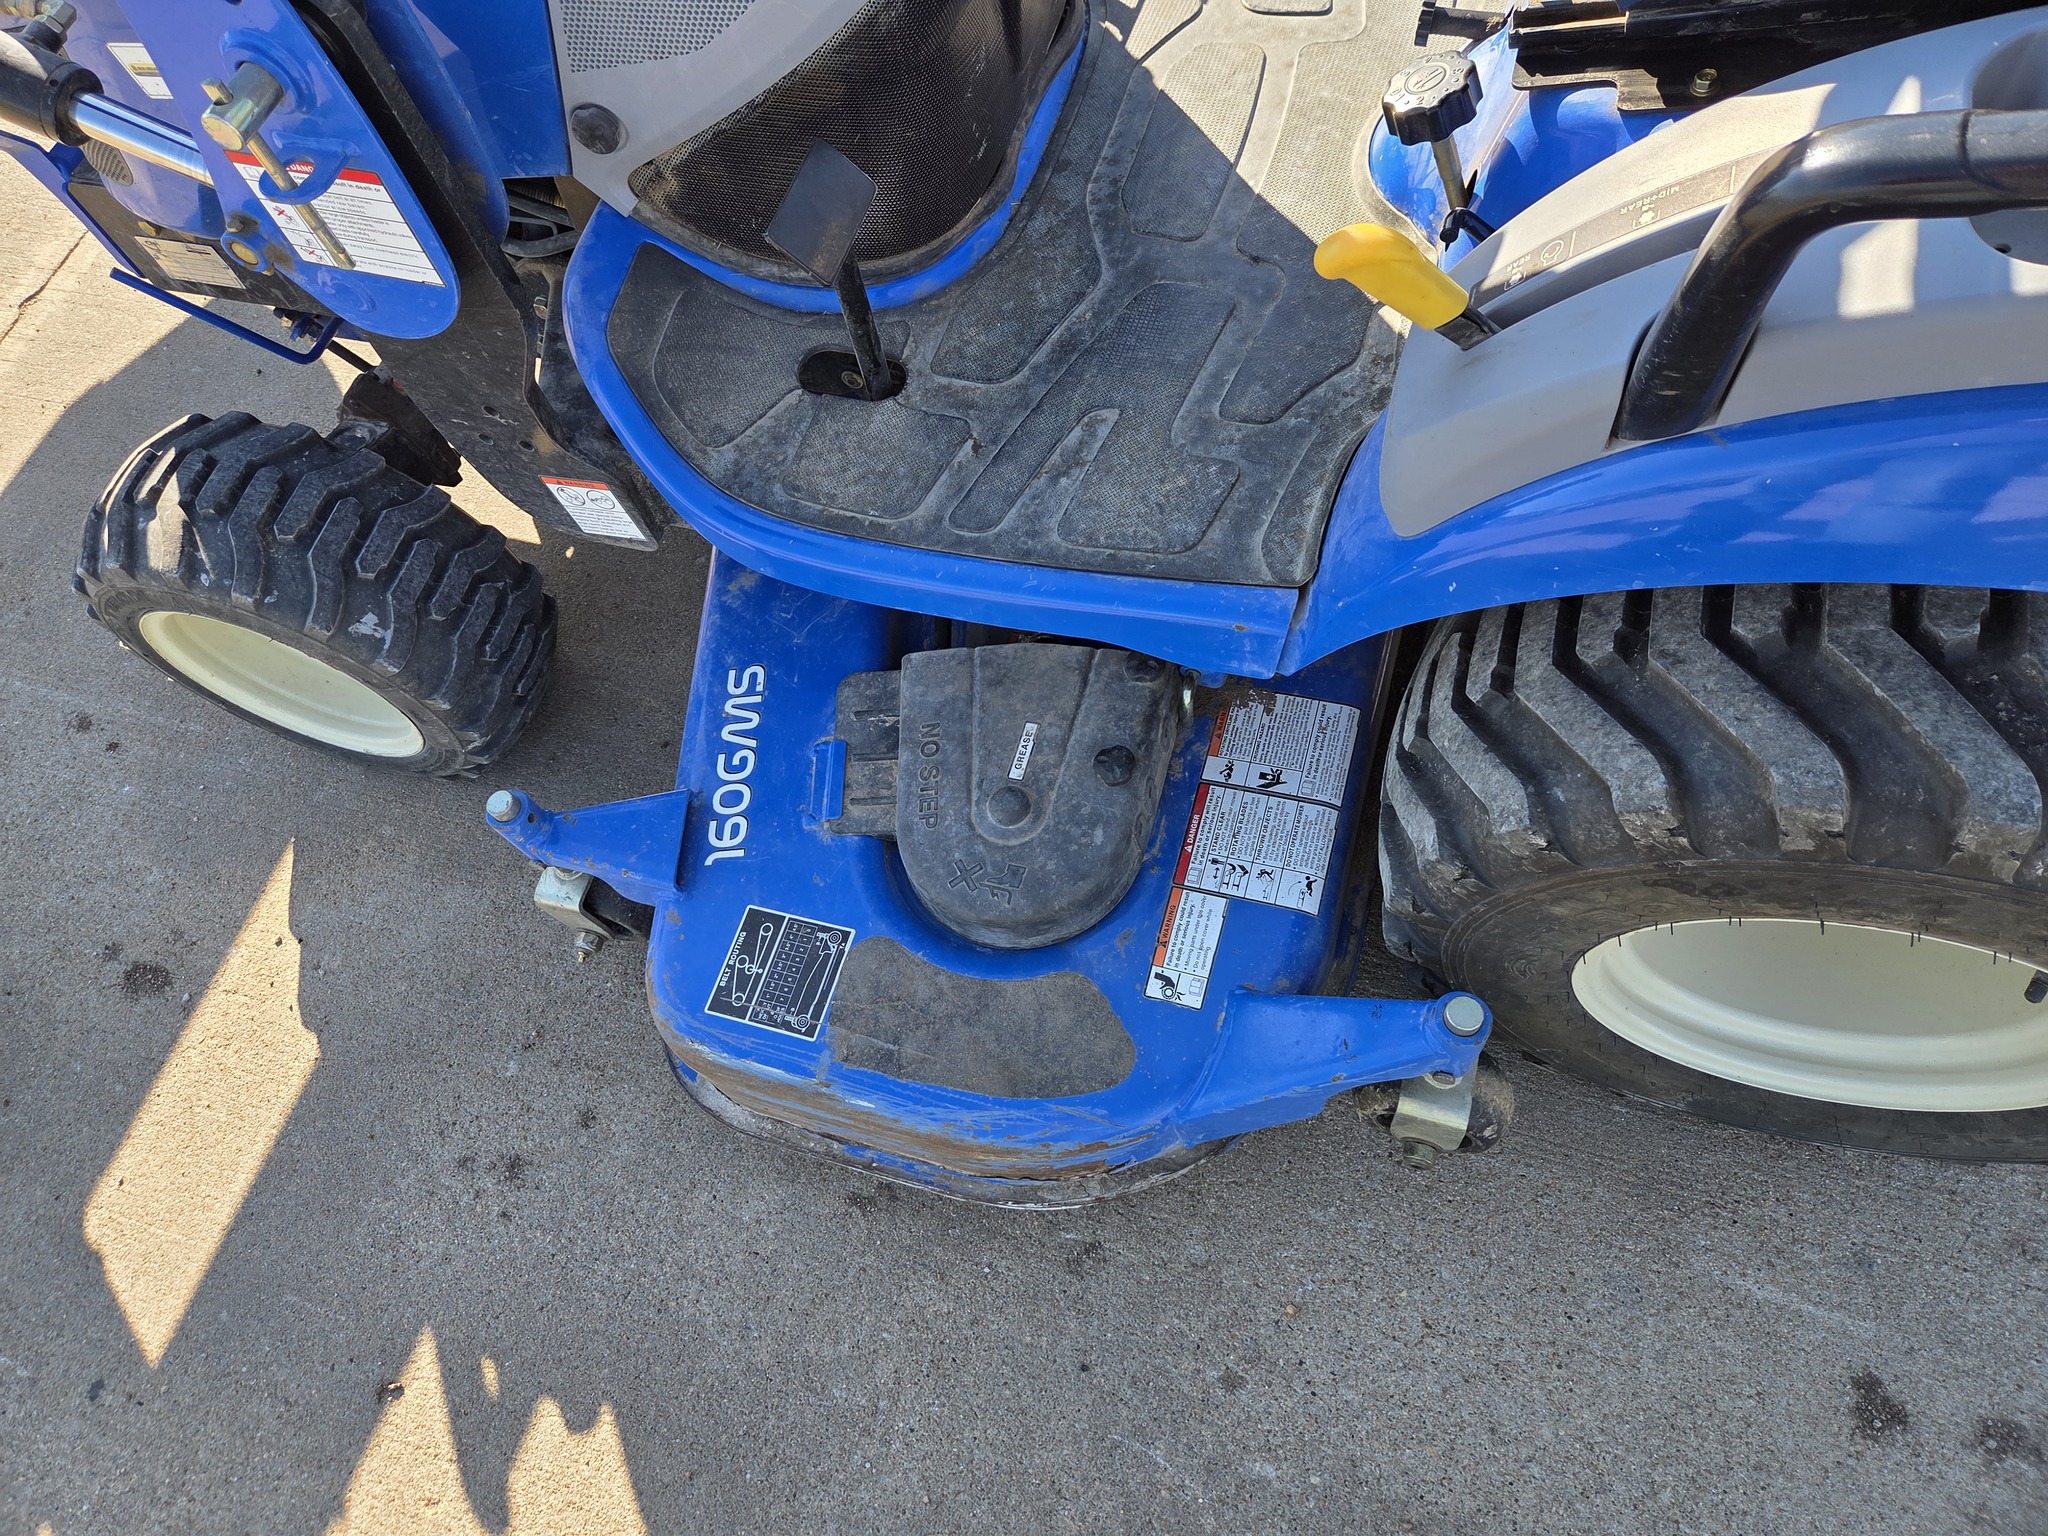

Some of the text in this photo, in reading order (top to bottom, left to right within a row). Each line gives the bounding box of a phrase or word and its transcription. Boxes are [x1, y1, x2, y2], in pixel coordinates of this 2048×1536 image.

[1619, 185, 1679, 215] MID+REAR
[1506, 253, 1530, 271] REAR
[1318, 703, 1327, 719] result
[1315, 718, 1323, 734] could
[1014, 730, 1034, 771] GREASE
[1311, 734, 1321, 754] comply
[1318, 732, 1327, 751] serious
[1316, 751, 1323, 759] or
[704, 664, 766, 866] 160GMS
[1305, 760, 1314, 779] Failure
[918, 722, 941, 829] NO STEP
[1206, 786, 1216, 804] result
[1212, 793, 1222, 812] injury.
[1203, 803, 1212, 815] will
[1186, 813, 1200, 843] DANGER
[1198, 815, 1210, 837] comply
[1206, 812, 1216, 834] serious
[1217, 842, 1224, 851] DO
[1229, 790, 1237, 806] mower
[1229, 800, 1249, 856] ROTATING BLADES
[1300, 813, 1309, 830] without
[1322, 814, 1331, 834] children
[1204, 834, 1210, 842] or
[1210, 810, 1226, 852] STAND CLEAR
[1236, 846, 1243, 855] DO
[1244, 811, 1252, 826] hands
[1242, 841, 1250, 856] under
[1250, 809, 1258, 825] mower
[1254, 805, 1273, 861] THROWN OBJECTS
[1285, 804, 1304, 868] DO NOT OPERATE MOWER
[1296, 829, 1305, 847] operate
[1199, 841, 1209, 859] death
[1318, 833, 1327, 852] ALLOW
[1190, 843, 1201, 864] Failure
[1292, 857, 1299, 866] DO
[1314, 862, 1321, 871] DO
[1182, 891, 1191, 906] result
[1199, 895, 1207, 909] cover
[1160, 904, 1176, 939] WARNING
[1177, 906, 1186, 922] could
[1204, 907, 1212, 922] while
[1172, 921, 1183, 942] comply
[1174, 945, 1184, 962] death
[1181, 919, 1191, 939] serious
[1186, 902, 1196, 919] injury.
[1192, 919, 1201, 934] under
[1201, 922, 1209, 937] cover
[1189, 934, 1197, 948] parts
[1198, 937, 1206, 951] open
[718, 930, 747, 987] BELT ROUTING
[1165, 947, 1175, 966] Failure
[1184, 947, 1194, 967] Moving
[1193, 959, 1199, 969] Do
[1199, 945, 1211, 971] operating
